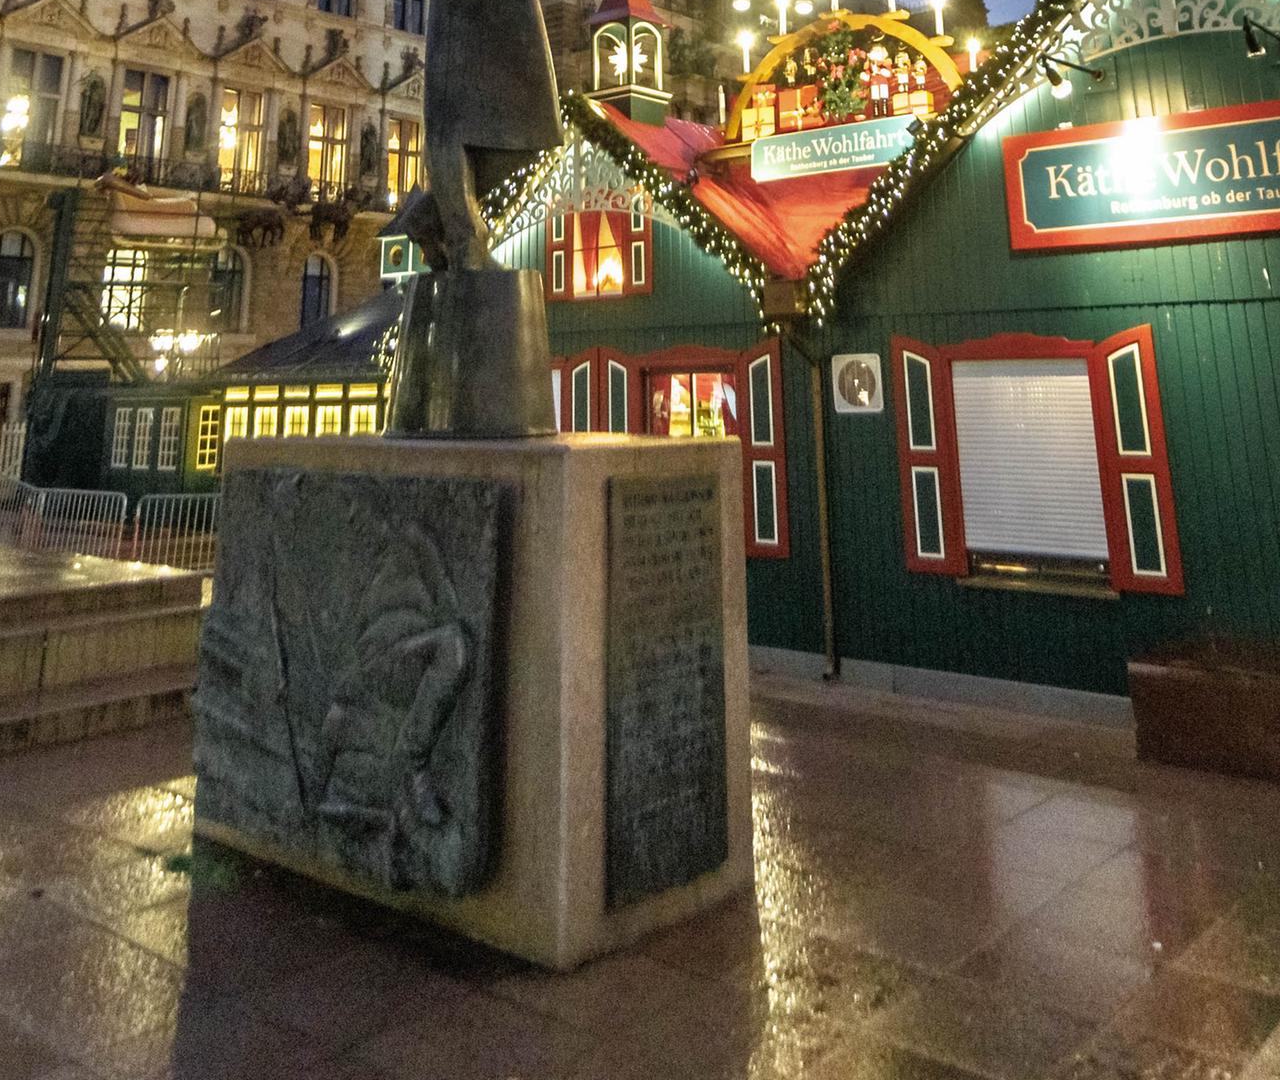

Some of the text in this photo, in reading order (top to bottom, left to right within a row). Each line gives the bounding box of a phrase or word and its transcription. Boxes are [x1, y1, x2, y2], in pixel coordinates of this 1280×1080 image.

[763, 129, 907, 165] Käthe Wohlfahrt
[1045, 154, 1157, 199] Käte
[1201, 191, 1221, 206] ob
[1226, 189, 1251, 204] der
